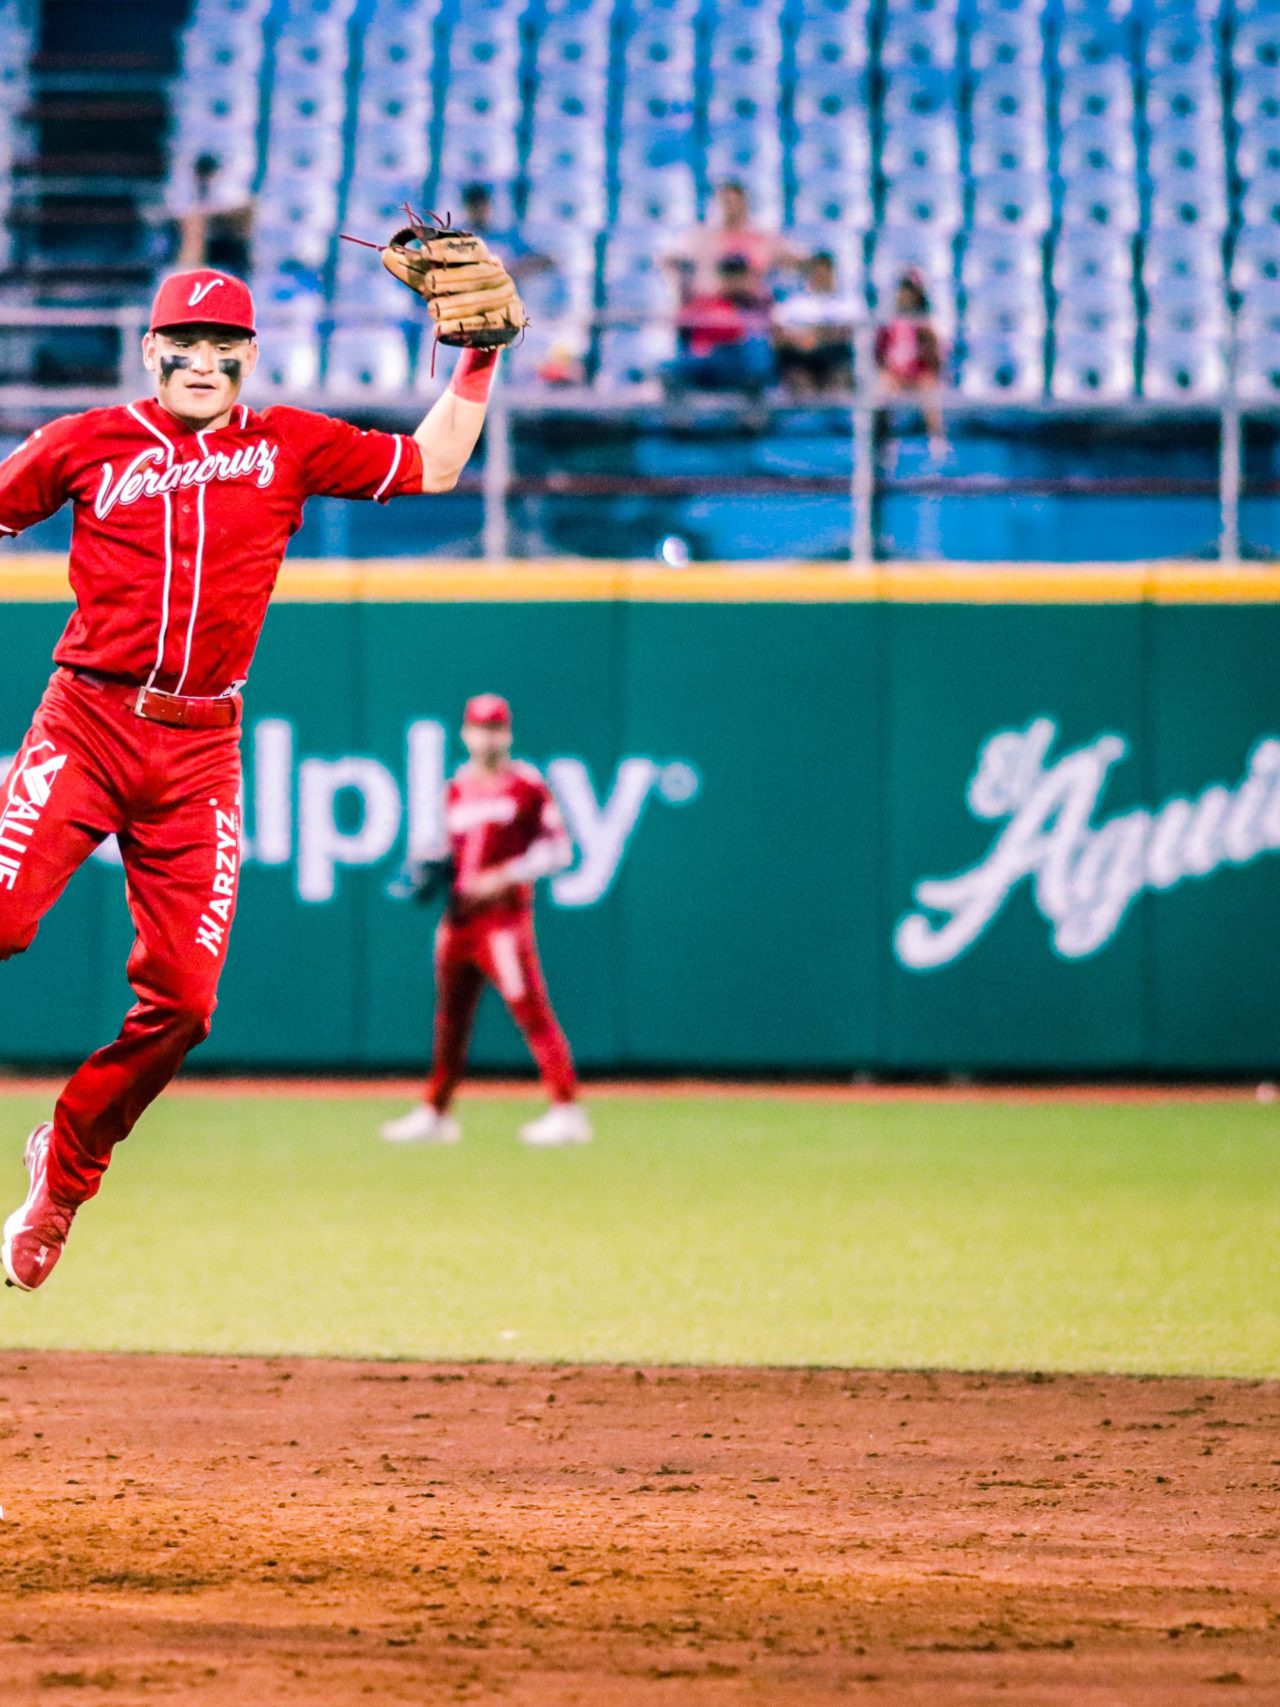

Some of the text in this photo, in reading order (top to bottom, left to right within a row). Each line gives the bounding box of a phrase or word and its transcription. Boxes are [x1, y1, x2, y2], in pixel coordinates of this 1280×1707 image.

[188, 279, 224, 307] V
[94, 439, 278, 521] Veracruz
[895, 735, 1280, 968] Agui
